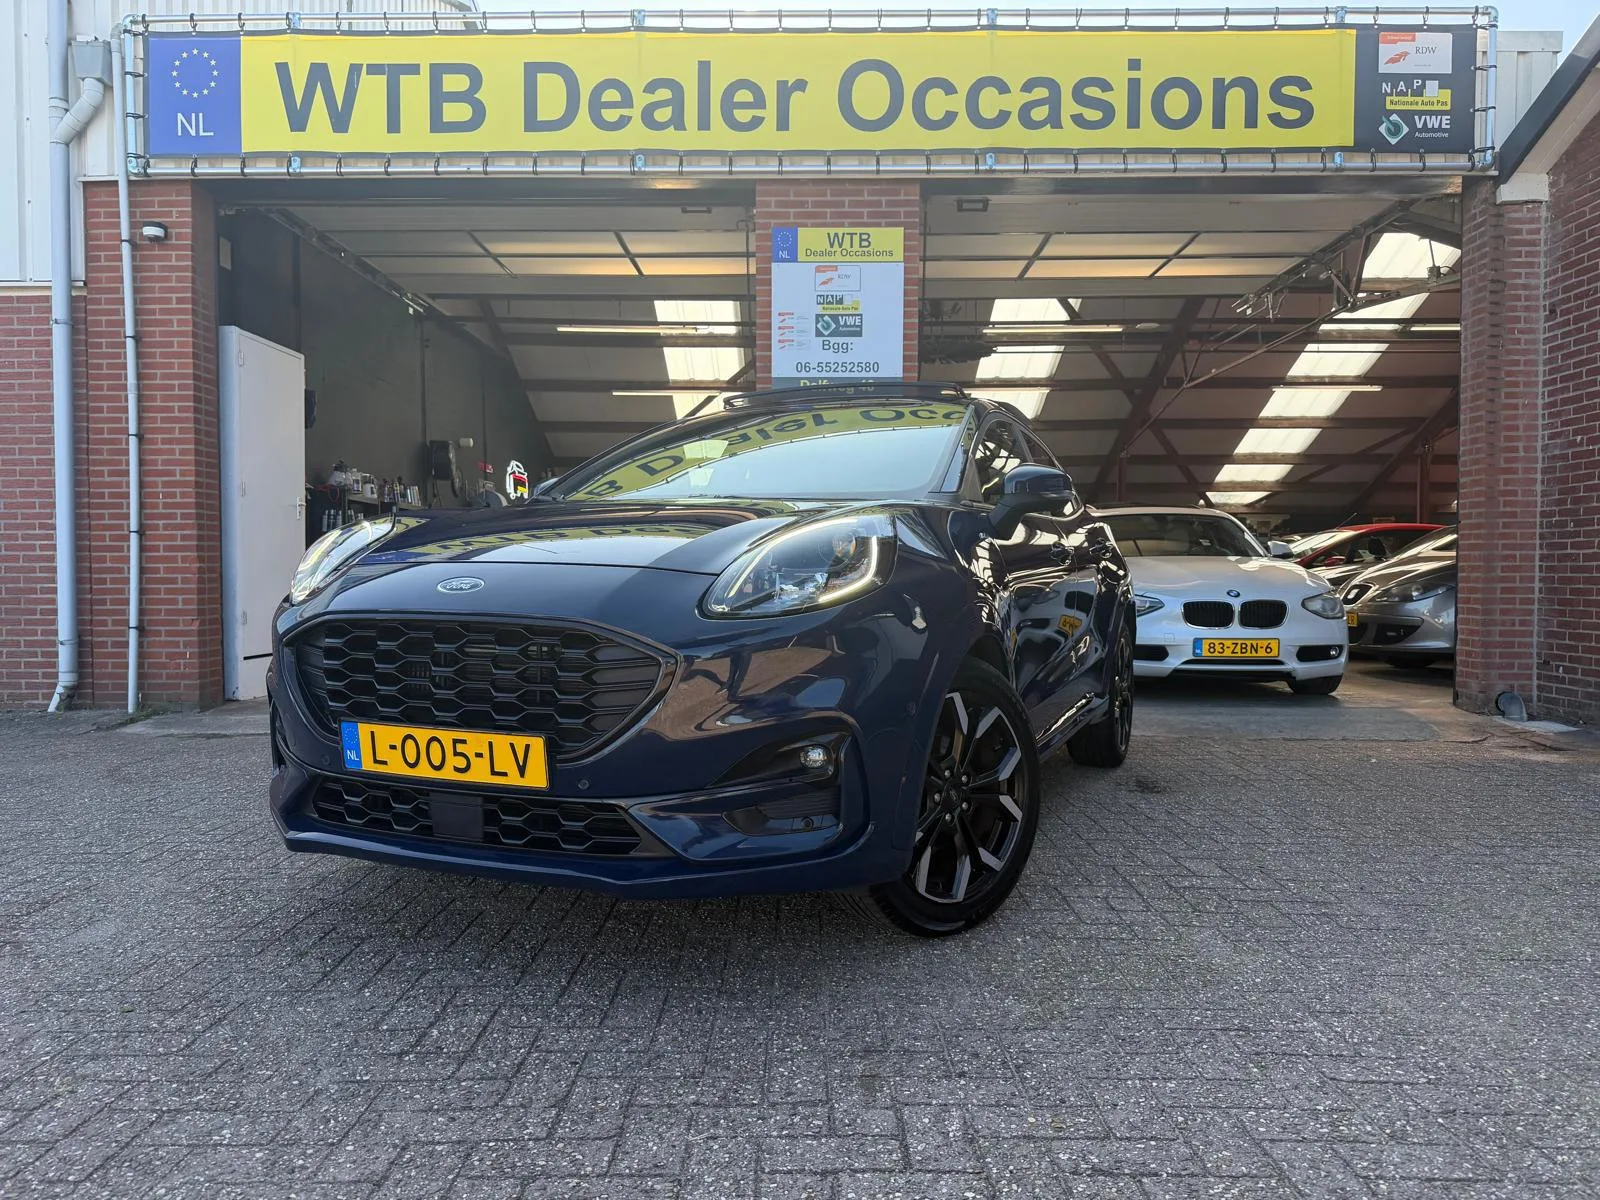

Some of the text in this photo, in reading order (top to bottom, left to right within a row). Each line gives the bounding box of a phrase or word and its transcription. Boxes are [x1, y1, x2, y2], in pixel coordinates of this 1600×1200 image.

[1415, 46, 1437, 55] RDW
[275, 58, 1315, 134] WTB Dealer Occasions
[1389, 99, 1448, 107] Nationale Auto Pas
[177, 112, 214, 137] NL
[1414, 115, 1451, 129] VWE
[827, 232, 871, 249] WTB
[778, 250, 791, 259] NL
[805, 248, 894, 257] Dealer Occasions
[838, 315, 862, 325] VWE
[821, 339, 854, 354] Bgg:
[795, 361, 880, 373] 06-55252580
[1207, 642, 1273, 655] 83-ZBN-6
[347, 750, 360, 761] NL
[370, 730, 531, 778] L-005-LV
